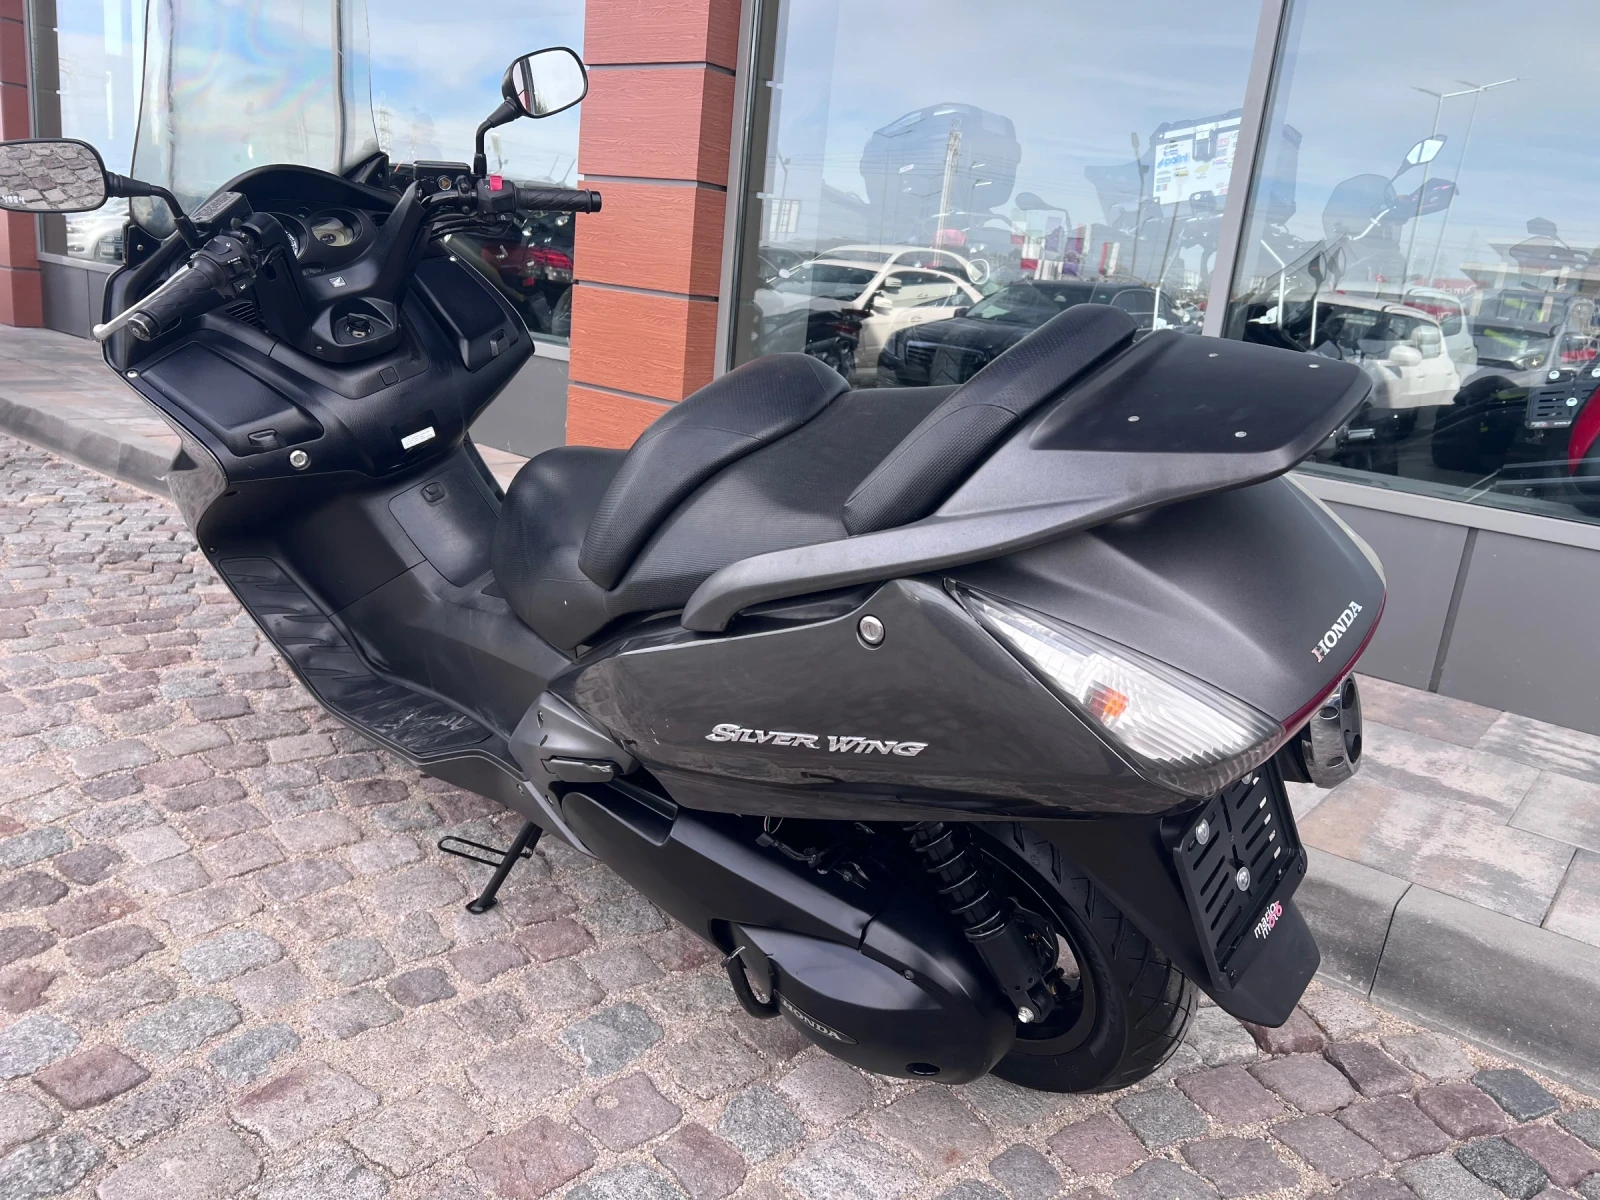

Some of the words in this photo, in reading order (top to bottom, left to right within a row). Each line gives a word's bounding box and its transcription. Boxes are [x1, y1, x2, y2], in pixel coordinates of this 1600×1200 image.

[1310, 600, 1363, 663] HONDA
[705, 723, 820, 749] SILVER
[827, 735, 929, 757] WING
[782, 998, 843, 1041] HONDA
